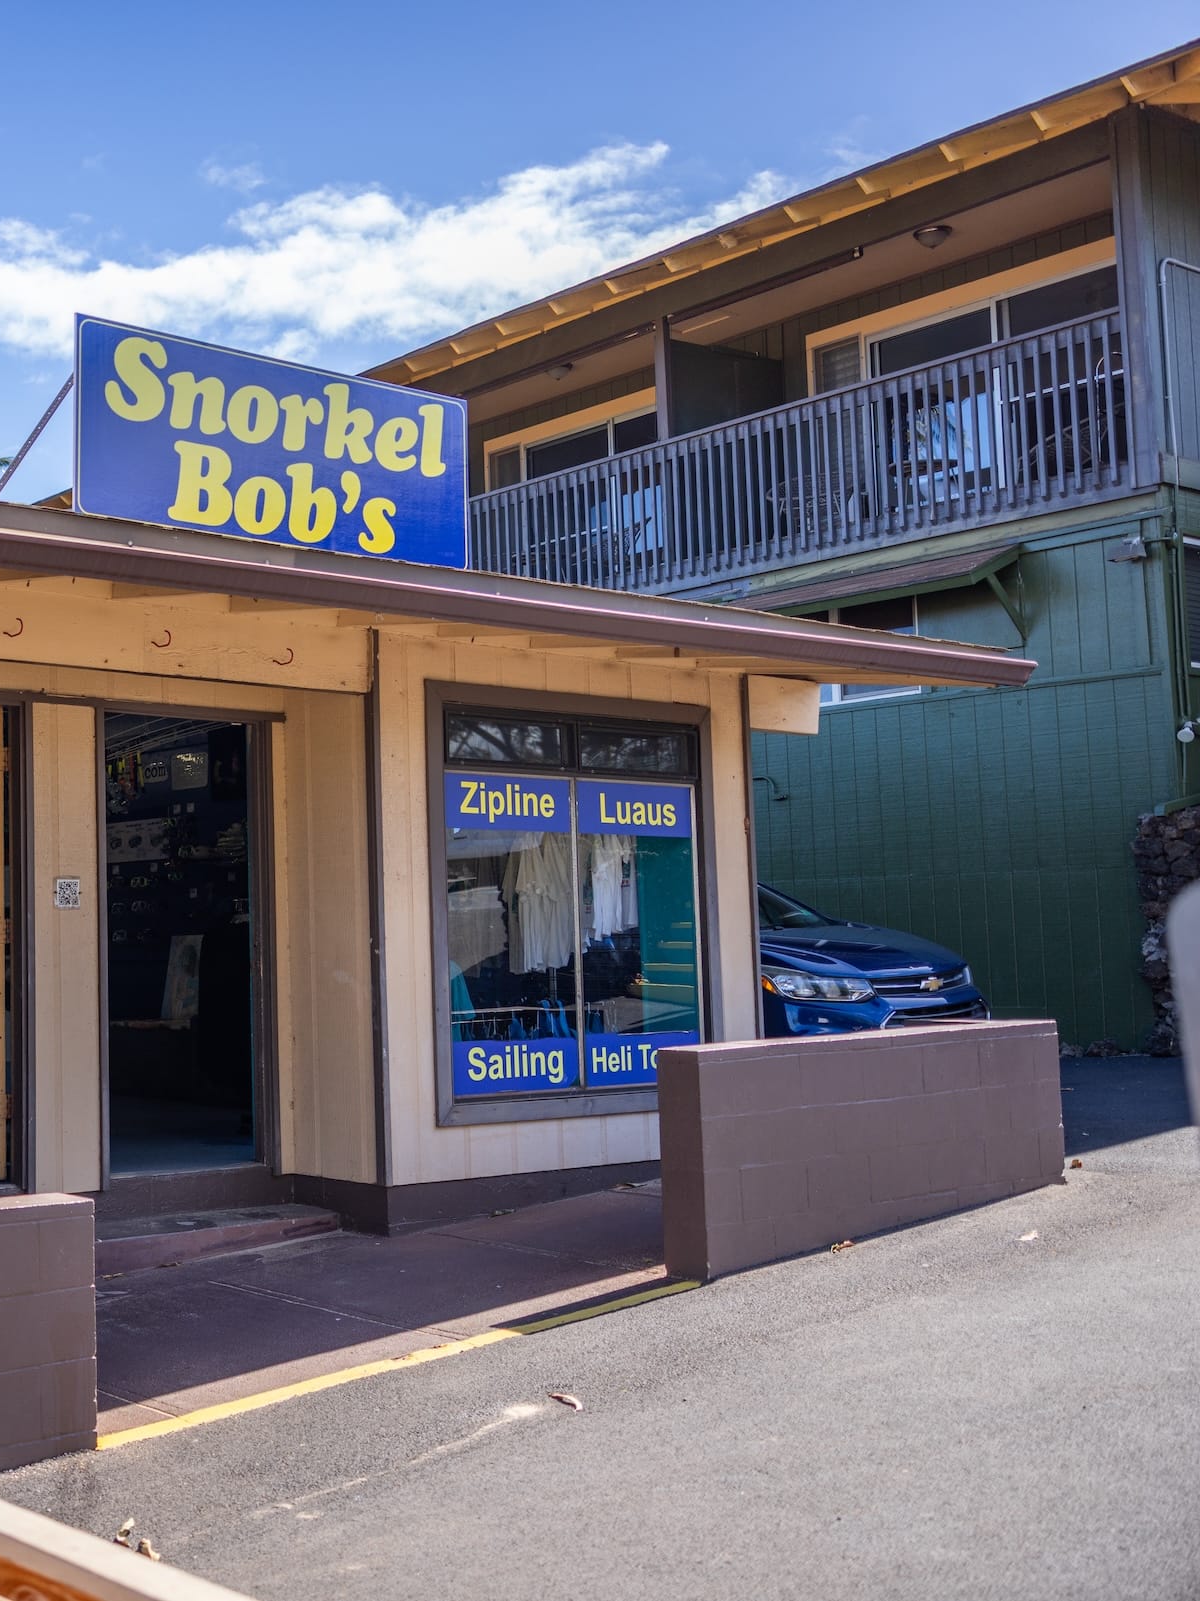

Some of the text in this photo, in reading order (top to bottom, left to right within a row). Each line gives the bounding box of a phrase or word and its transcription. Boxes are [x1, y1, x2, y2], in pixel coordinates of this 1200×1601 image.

[104, 337, 446, 477] Snorkel
[167, 440, 397, 554] Bob's
[459, 780, 555, 823] Zipline
[599, 792, 677, 827] Luaus
[467, 1045, 564, 1084] Sailing
[591, 1046, 633, 1074] Heli
